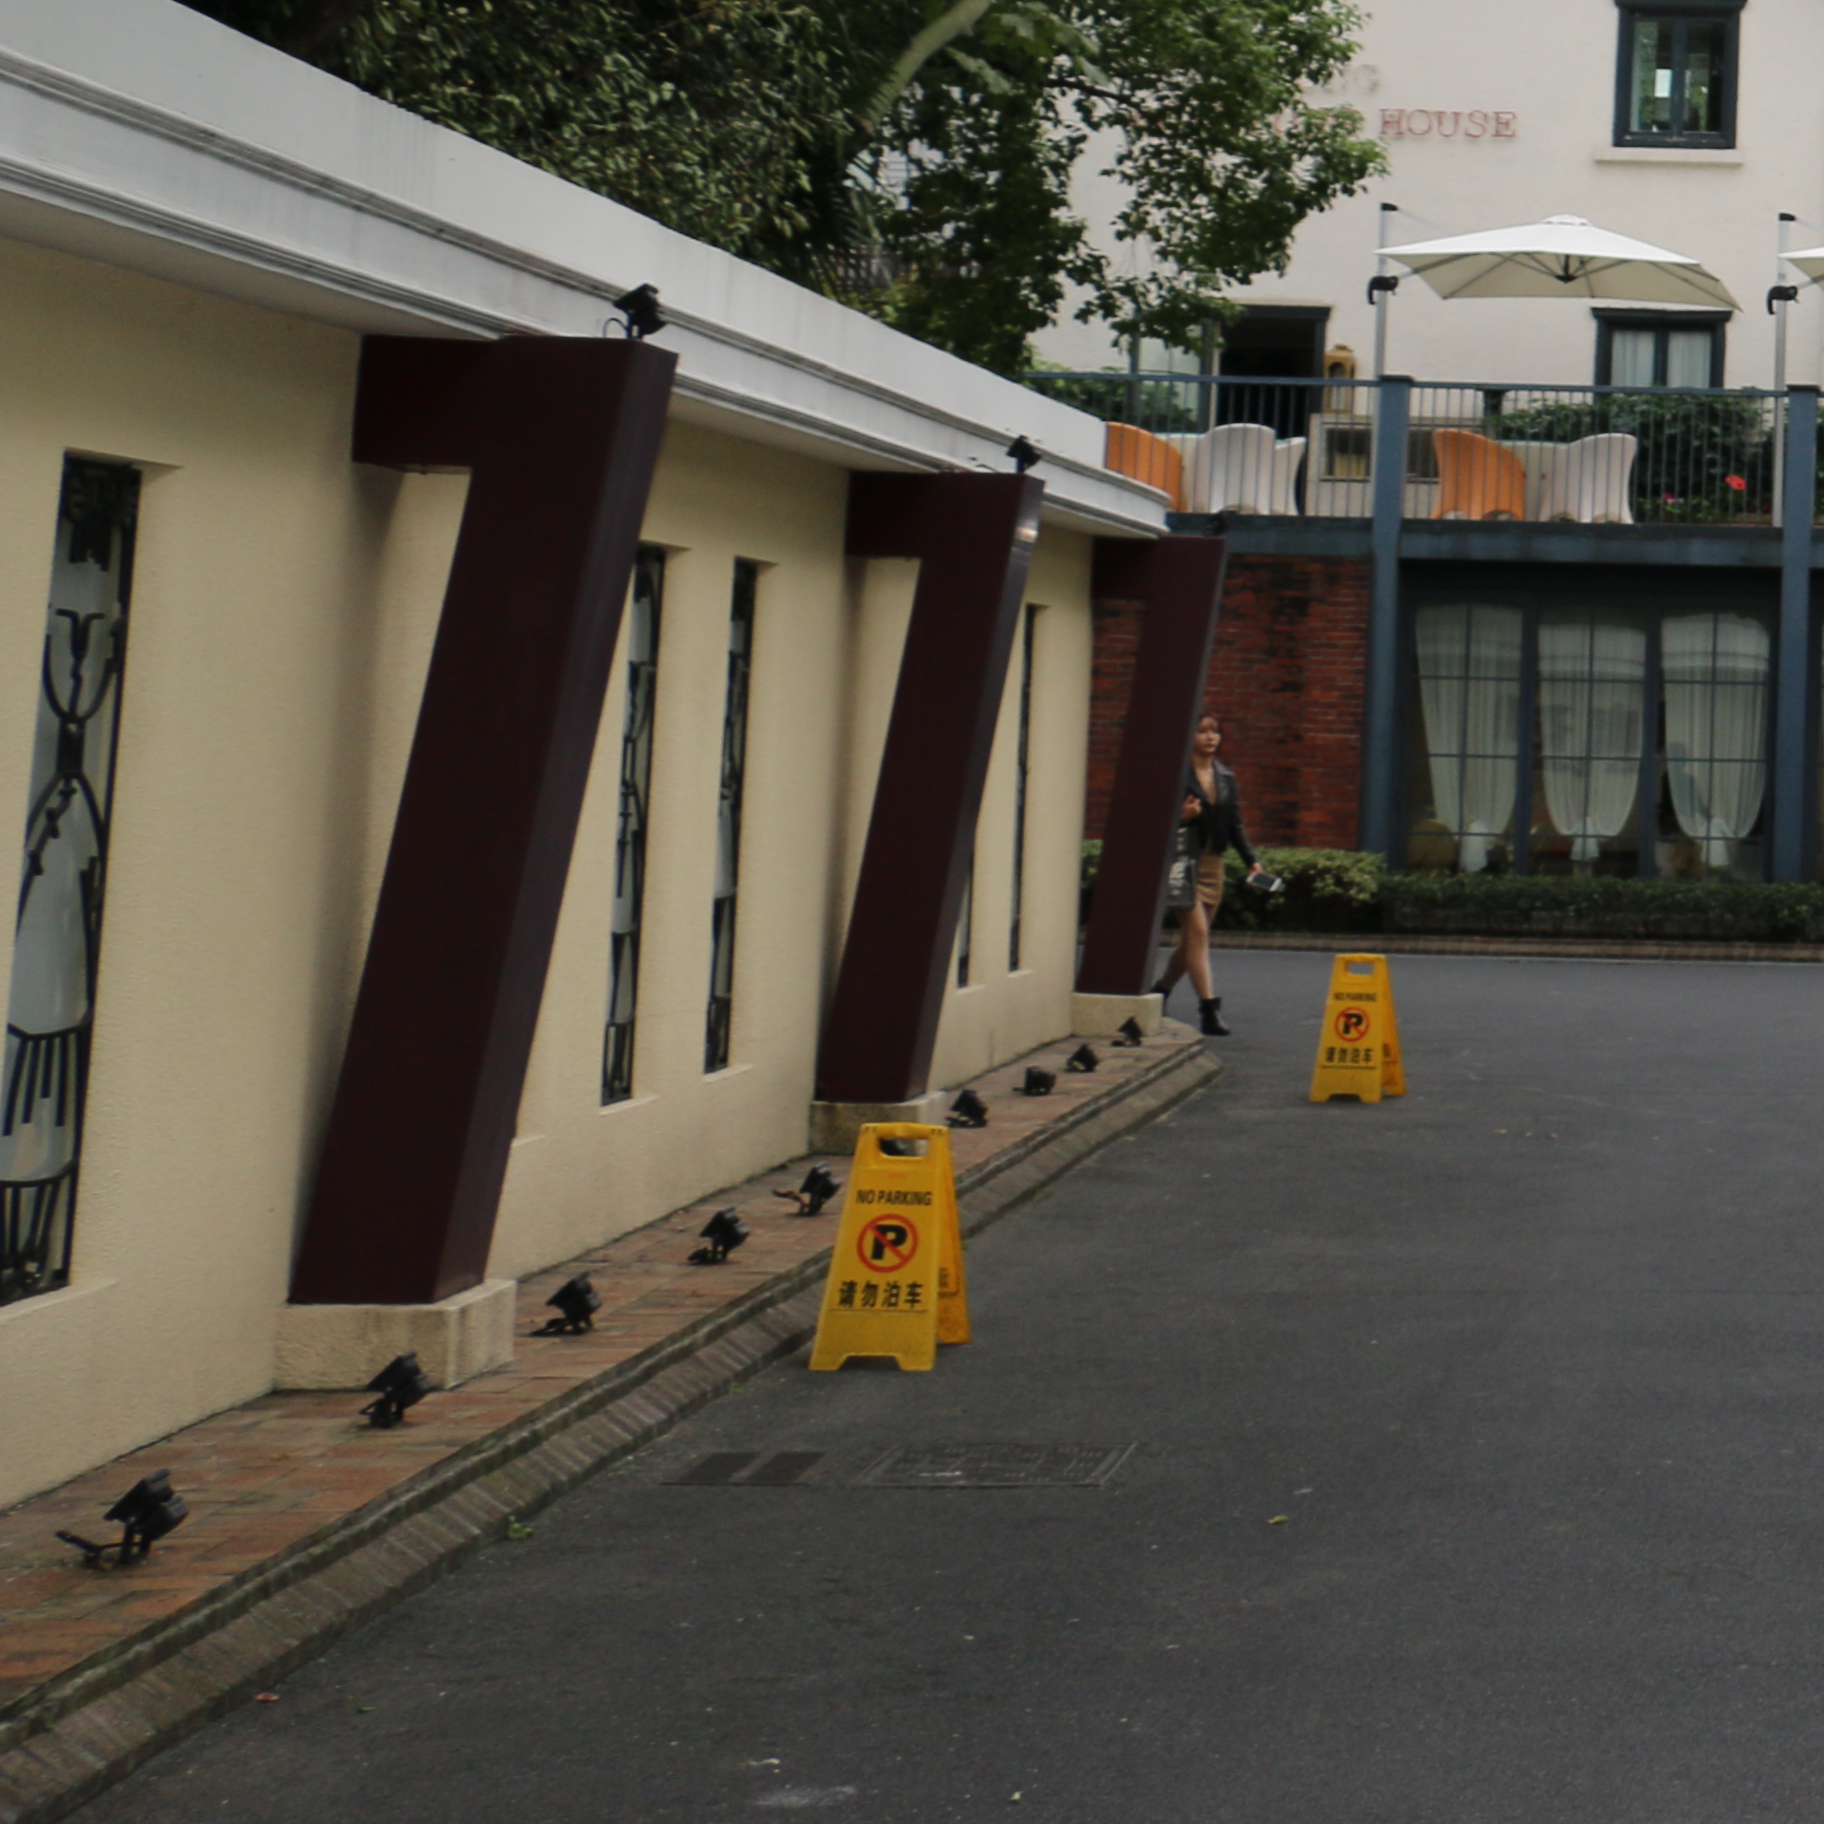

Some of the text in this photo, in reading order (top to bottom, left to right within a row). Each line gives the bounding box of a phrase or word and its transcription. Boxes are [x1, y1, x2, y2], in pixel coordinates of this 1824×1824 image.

[1378, 107, 1517, 139] HOUSE
[856, 1189, 933, 1206] NO PARKING
[838, 1280, 924, 1309] 请勿泊车
